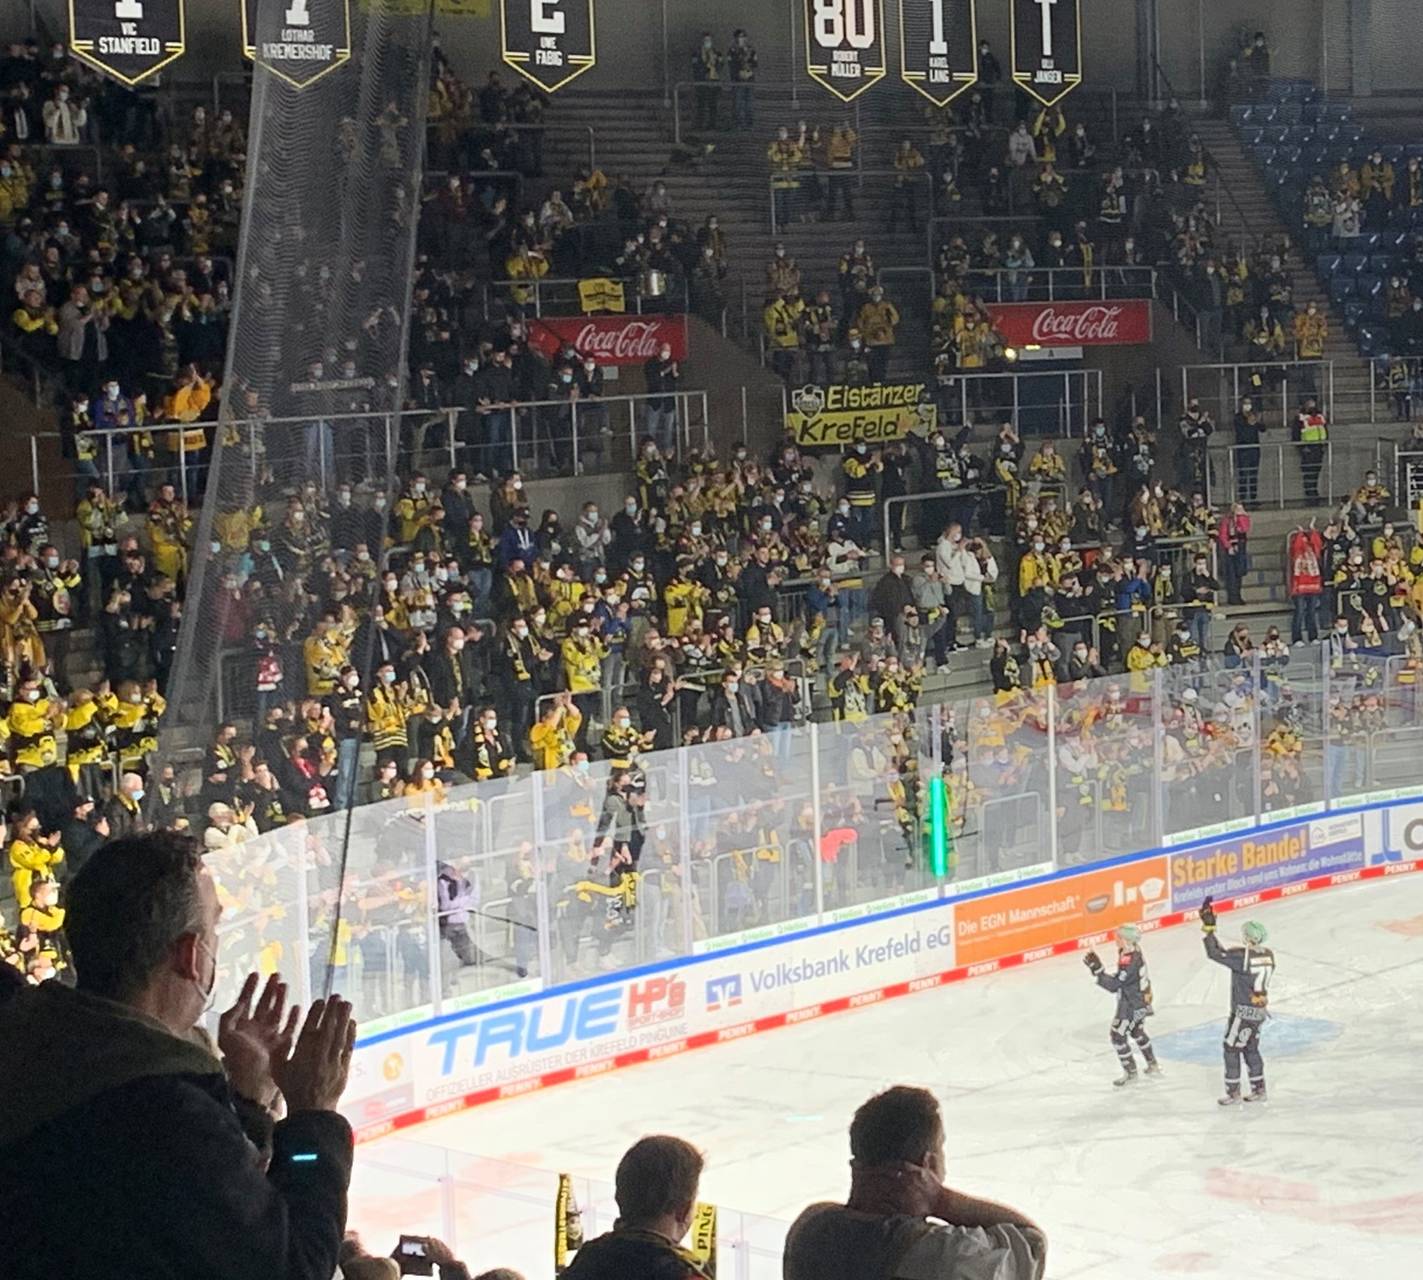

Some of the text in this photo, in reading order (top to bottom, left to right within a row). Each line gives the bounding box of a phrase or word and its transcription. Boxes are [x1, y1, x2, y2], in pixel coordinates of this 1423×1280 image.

[99, 37, 161, 55] STANFIELD
[262, 43, 334, 60] KREMERSHOF
[576, 322, 661, 357] Coca-Cola
[1032, 306, 1122, 340] Coca-Cola
[827, 382, 925, 409] Eistänzer
[1174, 829, 1307, 887] Starke Bande!
[957, 920, 977, 937] Die
[980, 912, 1006, 930] EGN
[750, 949, 849, 992] Volksbank
[855, 931, 921, 968] Krefeld
[926, 925, 951, 949] eG
[427, 986, 624, 1076] TRUE
[564, 1047, 588, 1067] DER
[590, 1035, 638, 1057] KREFELD
[639, 1022, 689, 1045] PINGUINE
